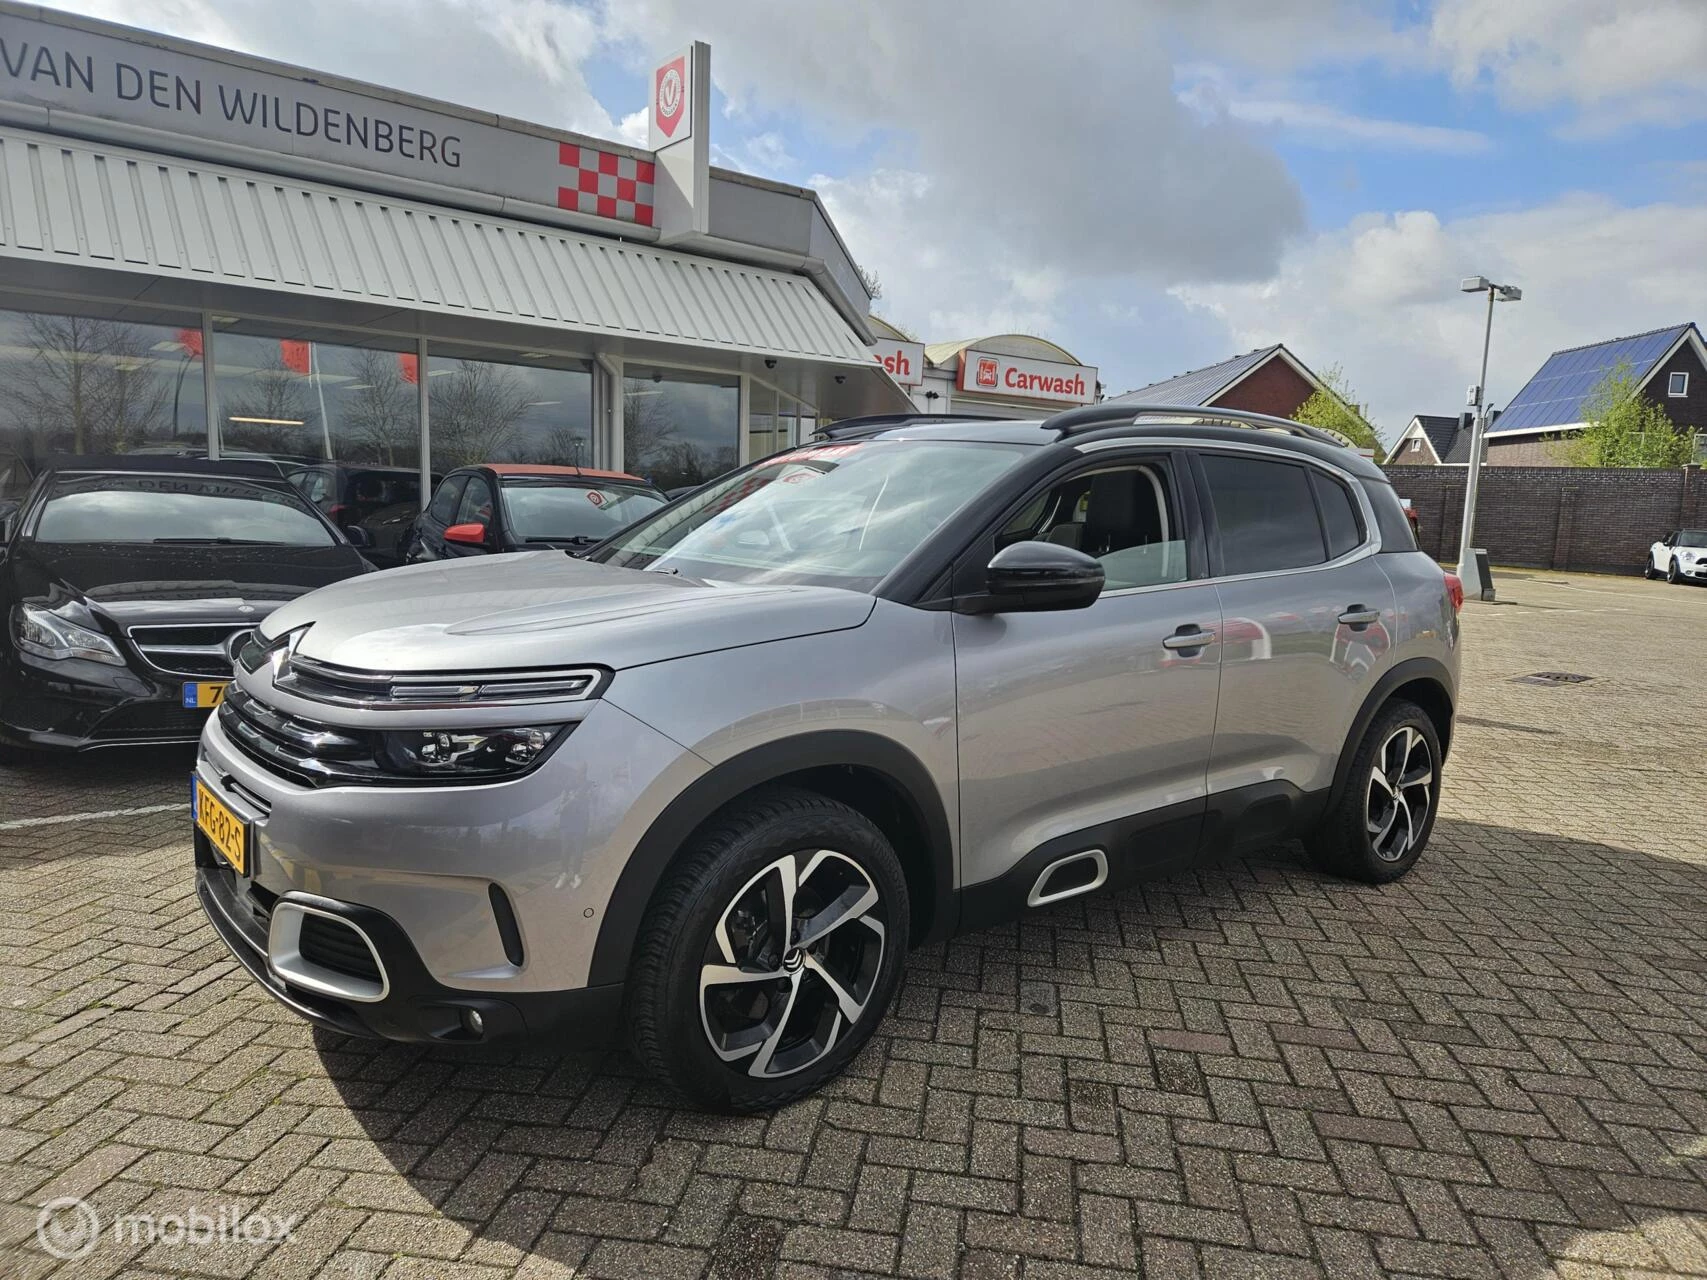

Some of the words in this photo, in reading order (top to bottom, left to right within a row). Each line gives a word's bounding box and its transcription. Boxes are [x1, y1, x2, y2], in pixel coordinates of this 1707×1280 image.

[0, 37, 94, 93] VAN
[116, 62, 201, 115] DEN
[218, 84, 462, 168] WILDENBERG
[1005, 367, 1085, 396] Carwash
[198, 788, 241, 862] KFG-82-S
